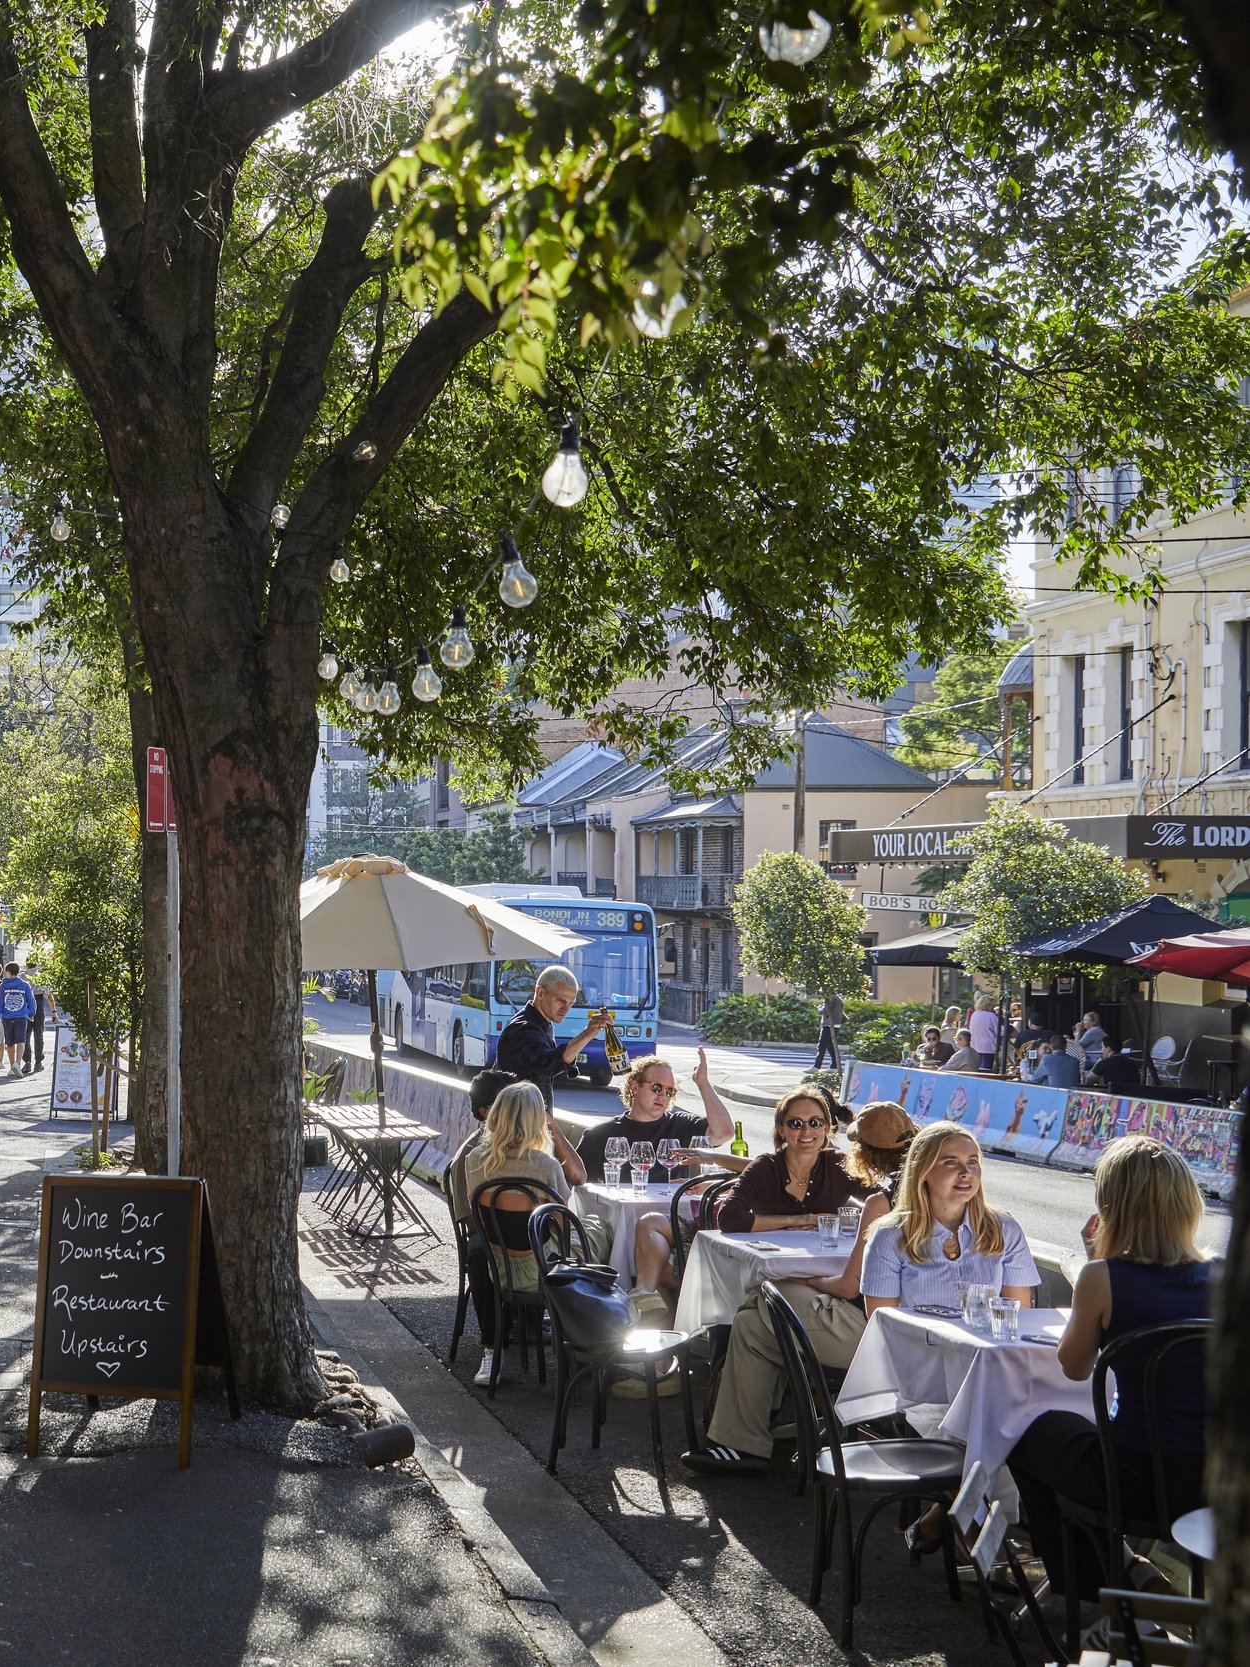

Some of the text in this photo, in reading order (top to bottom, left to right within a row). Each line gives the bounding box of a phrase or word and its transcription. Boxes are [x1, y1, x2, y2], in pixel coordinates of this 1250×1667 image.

[873, 833, 906, 857] YOUR
[908, 831, 950, 856] LOCAL
[1144, 821, 1250, 847] The LORD
[534, 909, 571, 918] BONDI
[869, 896, 911, 909] BOB'S
[596, 912, 625, 927] 389
[62, 1198, 163, 1234] Wine Bar
[58, 1240, 166, 1264] Downstairs
[52, 1285, 171, 1321] Restaurant
[61, 1329, 148, 1358] Upstairs
